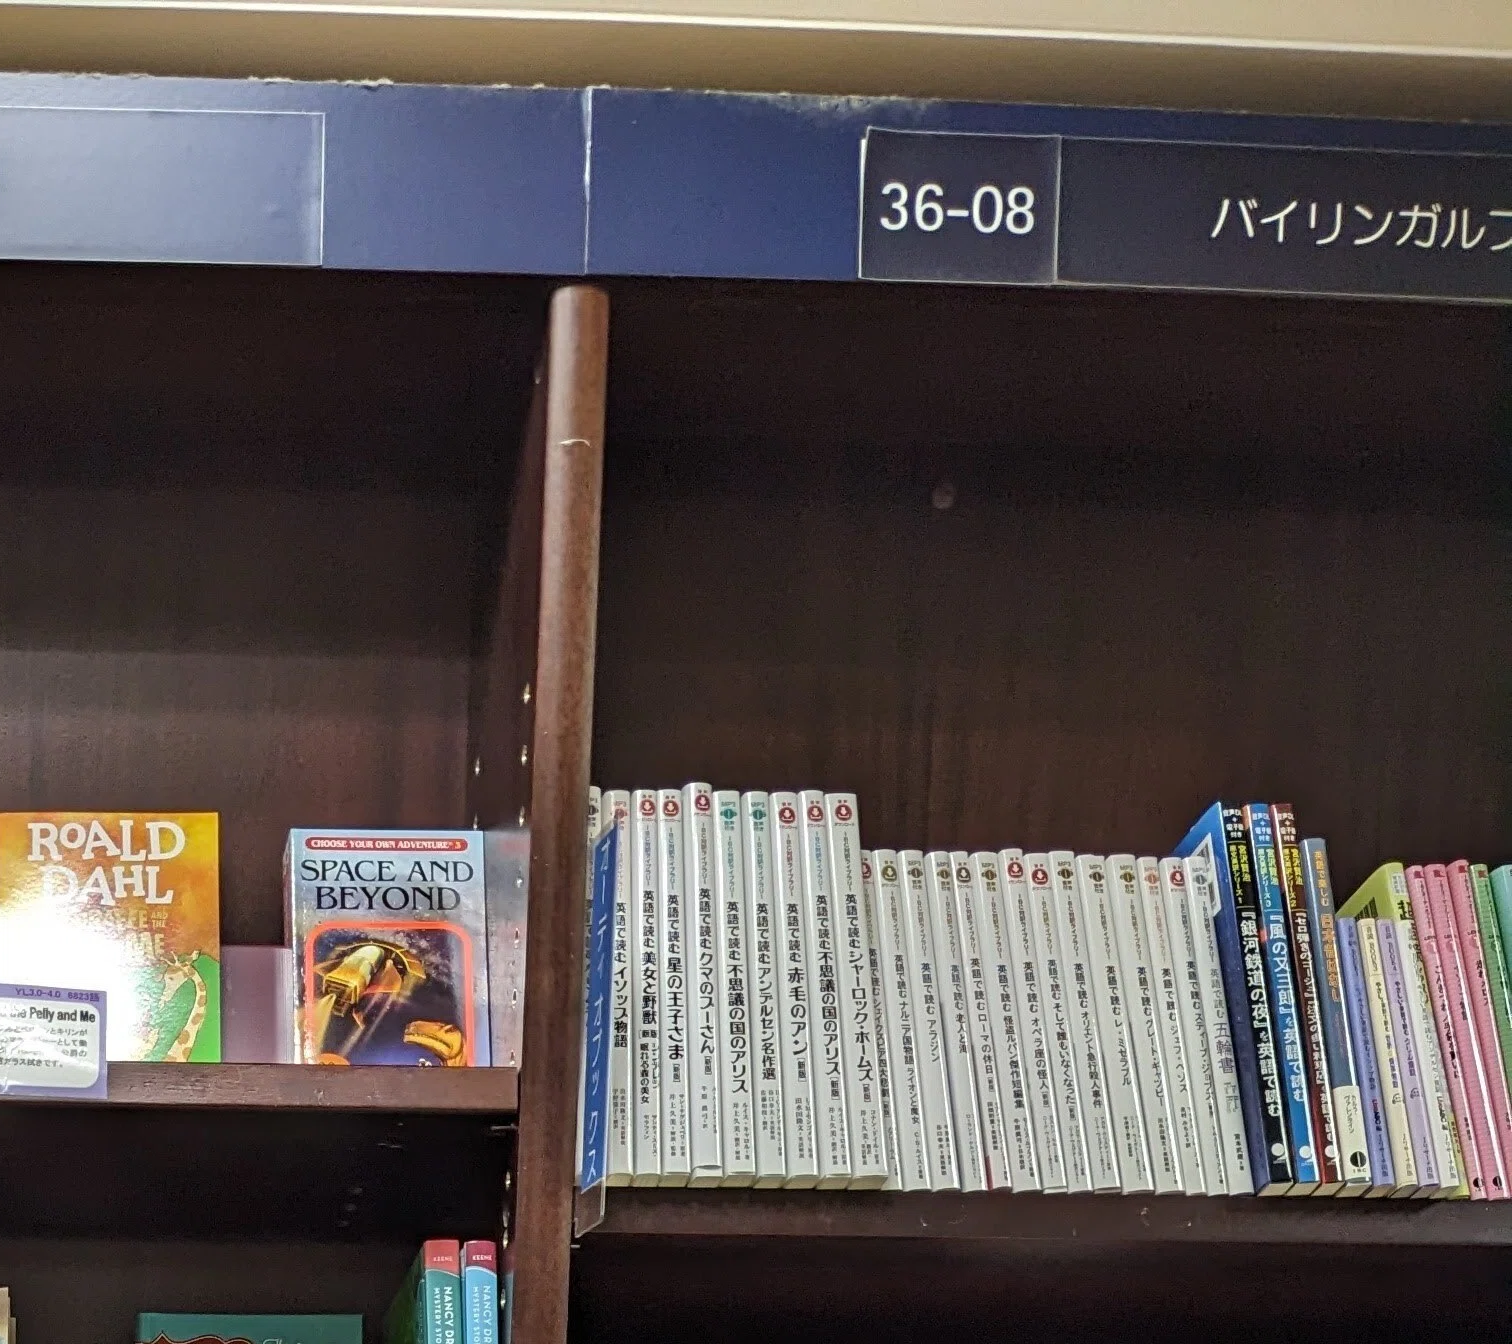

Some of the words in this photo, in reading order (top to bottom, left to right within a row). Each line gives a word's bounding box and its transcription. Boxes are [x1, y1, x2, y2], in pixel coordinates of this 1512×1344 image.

[880, 183, 1035, 234] 36-08
[27, 821, 186, 862] ROALD
[310, 839, 347, 849] CHOOSE
[350, 839, 374, 849] YOUR
[376, 839, 396, 849] OWN
[41, 866, 174, 905] DAHL
[301, 859, 397, 883] SPACE
[407, 860, 474, 883] AND
[315, 886, 462, 911] BEYOND
[666, 957, 684, 1060] 星の王子さま
